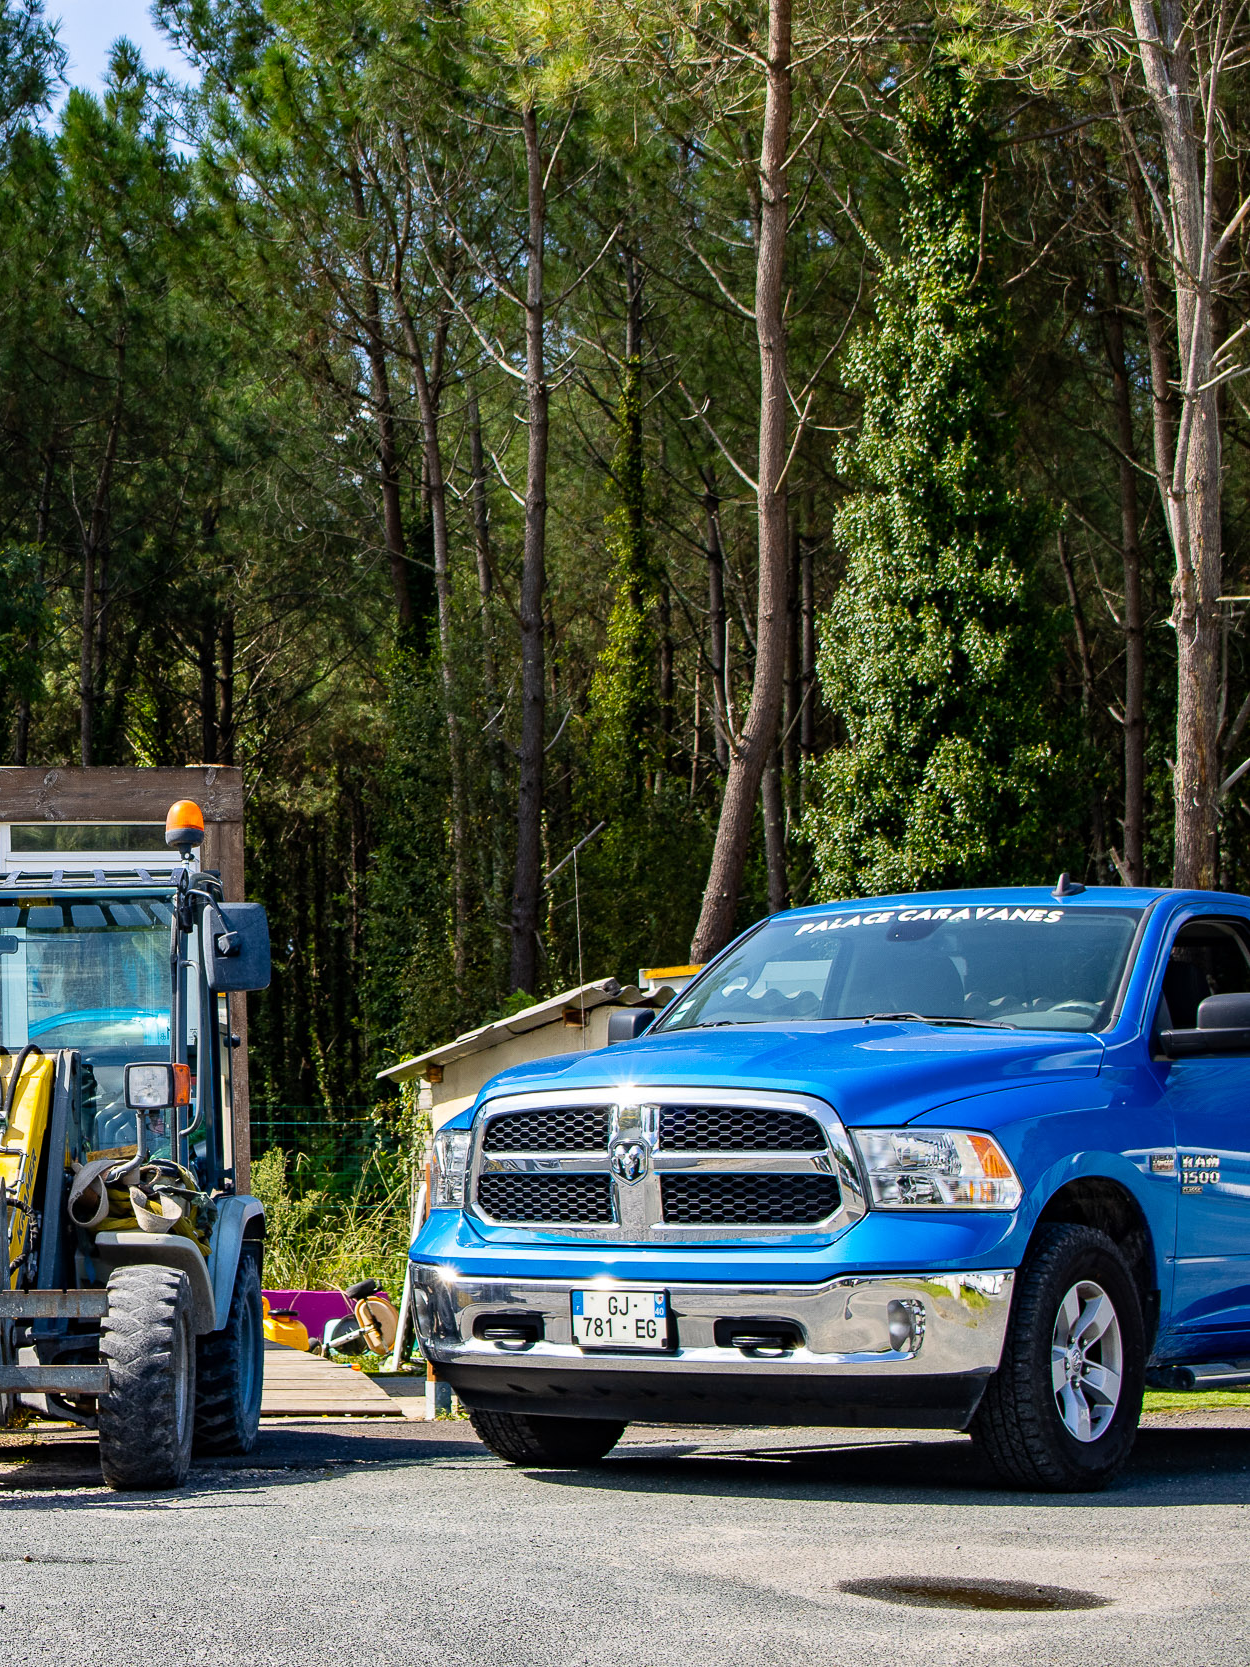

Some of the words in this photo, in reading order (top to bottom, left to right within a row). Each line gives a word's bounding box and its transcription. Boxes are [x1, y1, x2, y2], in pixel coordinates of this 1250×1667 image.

[794, 911, 895, 936] PALACE
[897, 907, 1065, 924] CARAVANES
[1181, 1155, 1220, 1169] RAM
[1181, 1169, 1220, 1185] 1500
[654, 1306, 664, 1316] 40
